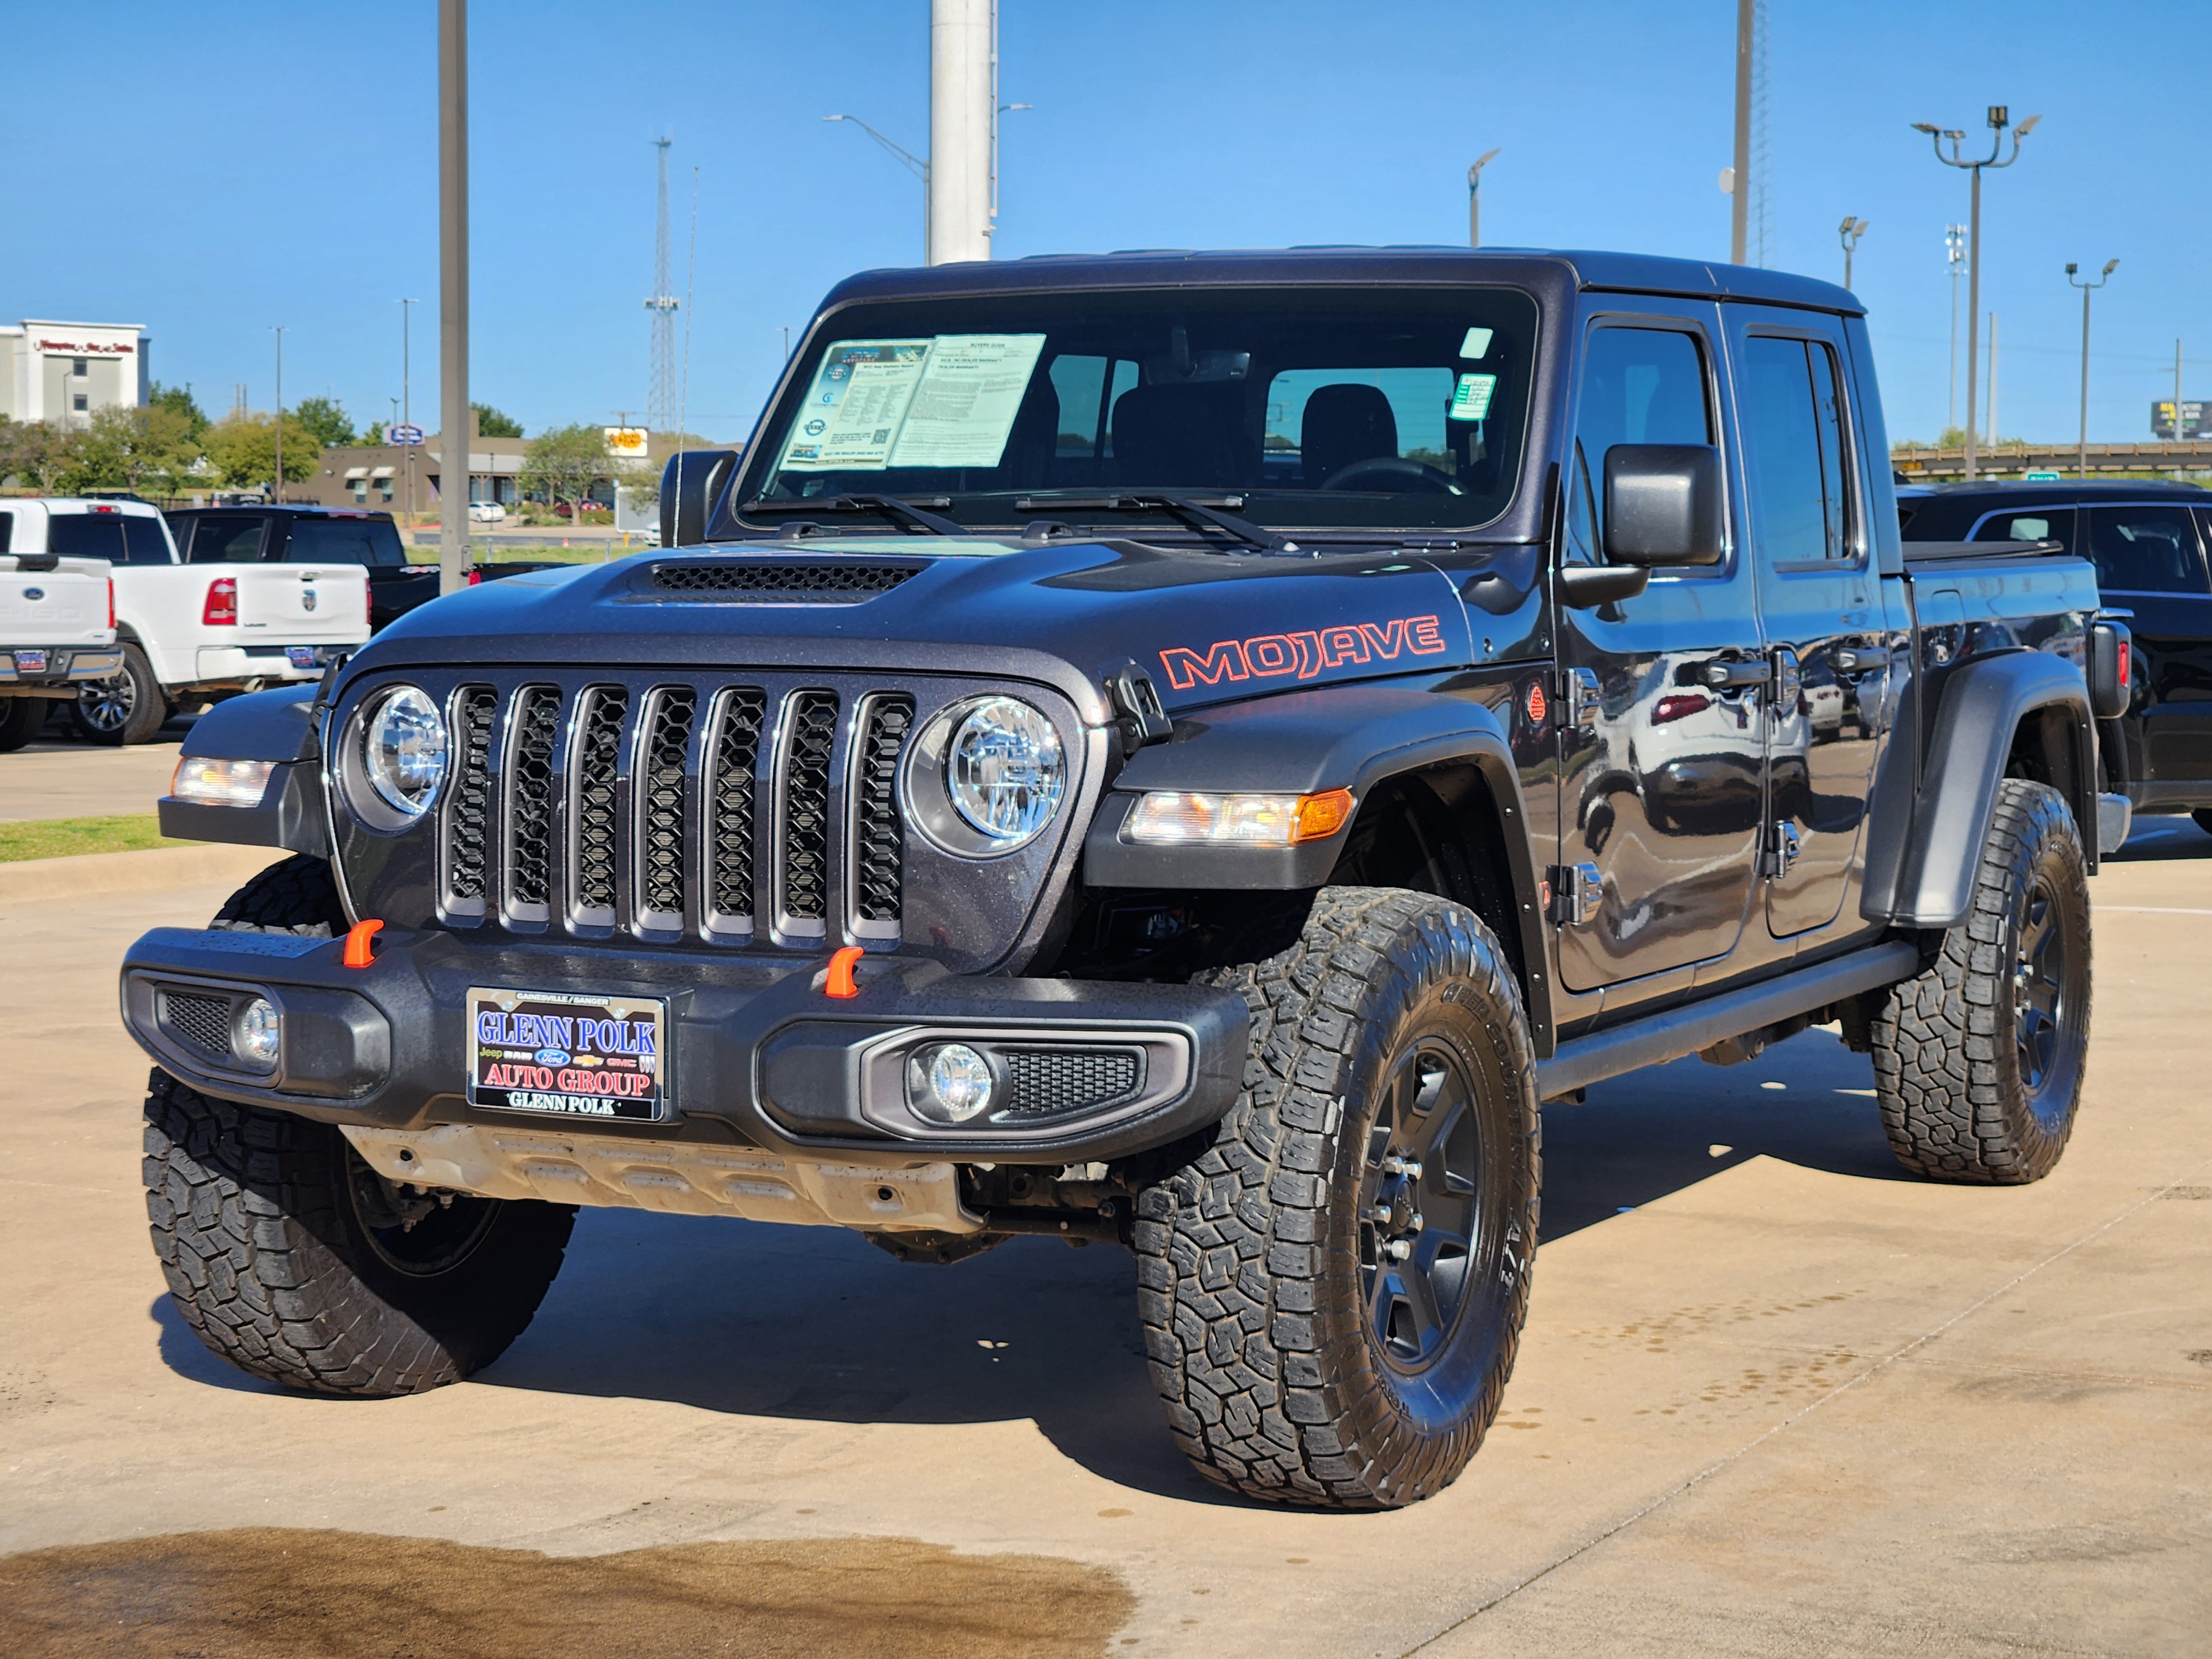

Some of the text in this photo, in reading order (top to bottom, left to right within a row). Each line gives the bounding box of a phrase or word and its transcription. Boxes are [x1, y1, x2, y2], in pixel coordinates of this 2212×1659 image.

[1159, 615, 1446, 690] MOJAVE
[477, 1010, 656, 1055] GLENN POLK
[479, 1046, 503, 1059] Jeep
[503, 1050, 533, 1061] RAM
[606, 1057, 637, 1068] GMC
[484, 1063, 650, 1097] AUTO GROUP
[508, 1091, 615, 1115] GLENN POLK
